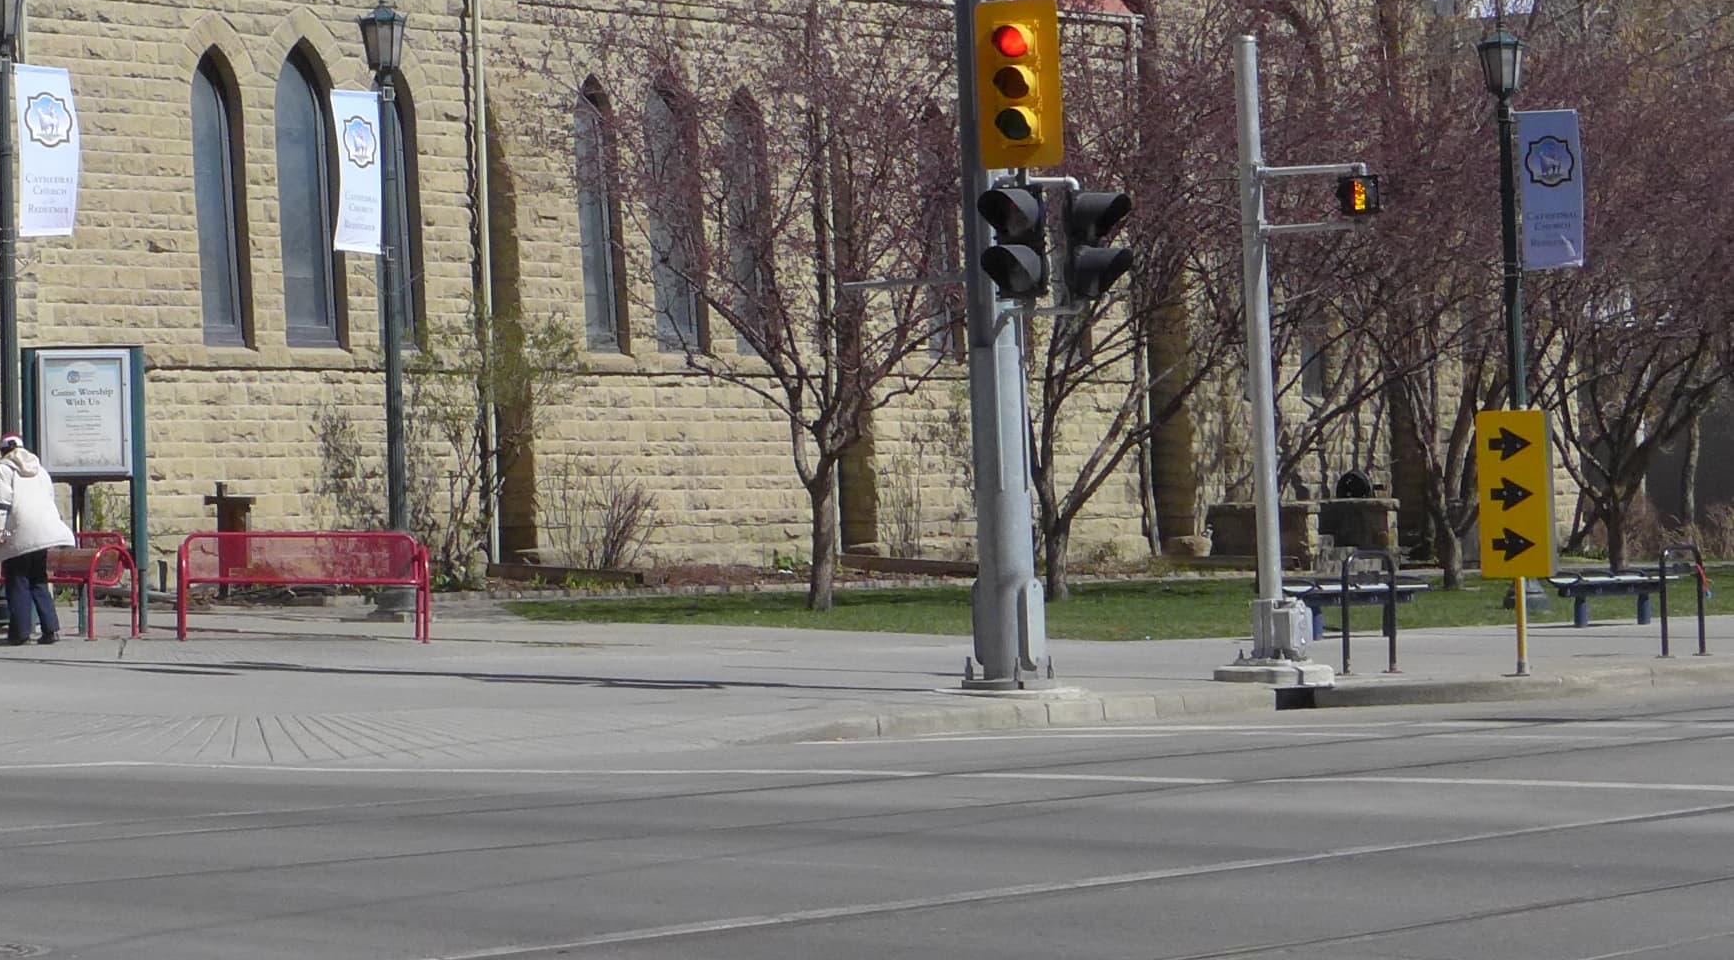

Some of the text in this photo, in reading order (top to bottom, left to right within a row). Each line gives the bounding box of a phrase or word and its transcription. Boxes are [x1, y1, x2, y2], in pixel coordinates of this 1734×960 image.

[51, 387, 114, 397] Come Worship
[66, 398, 100, 406] With Us
